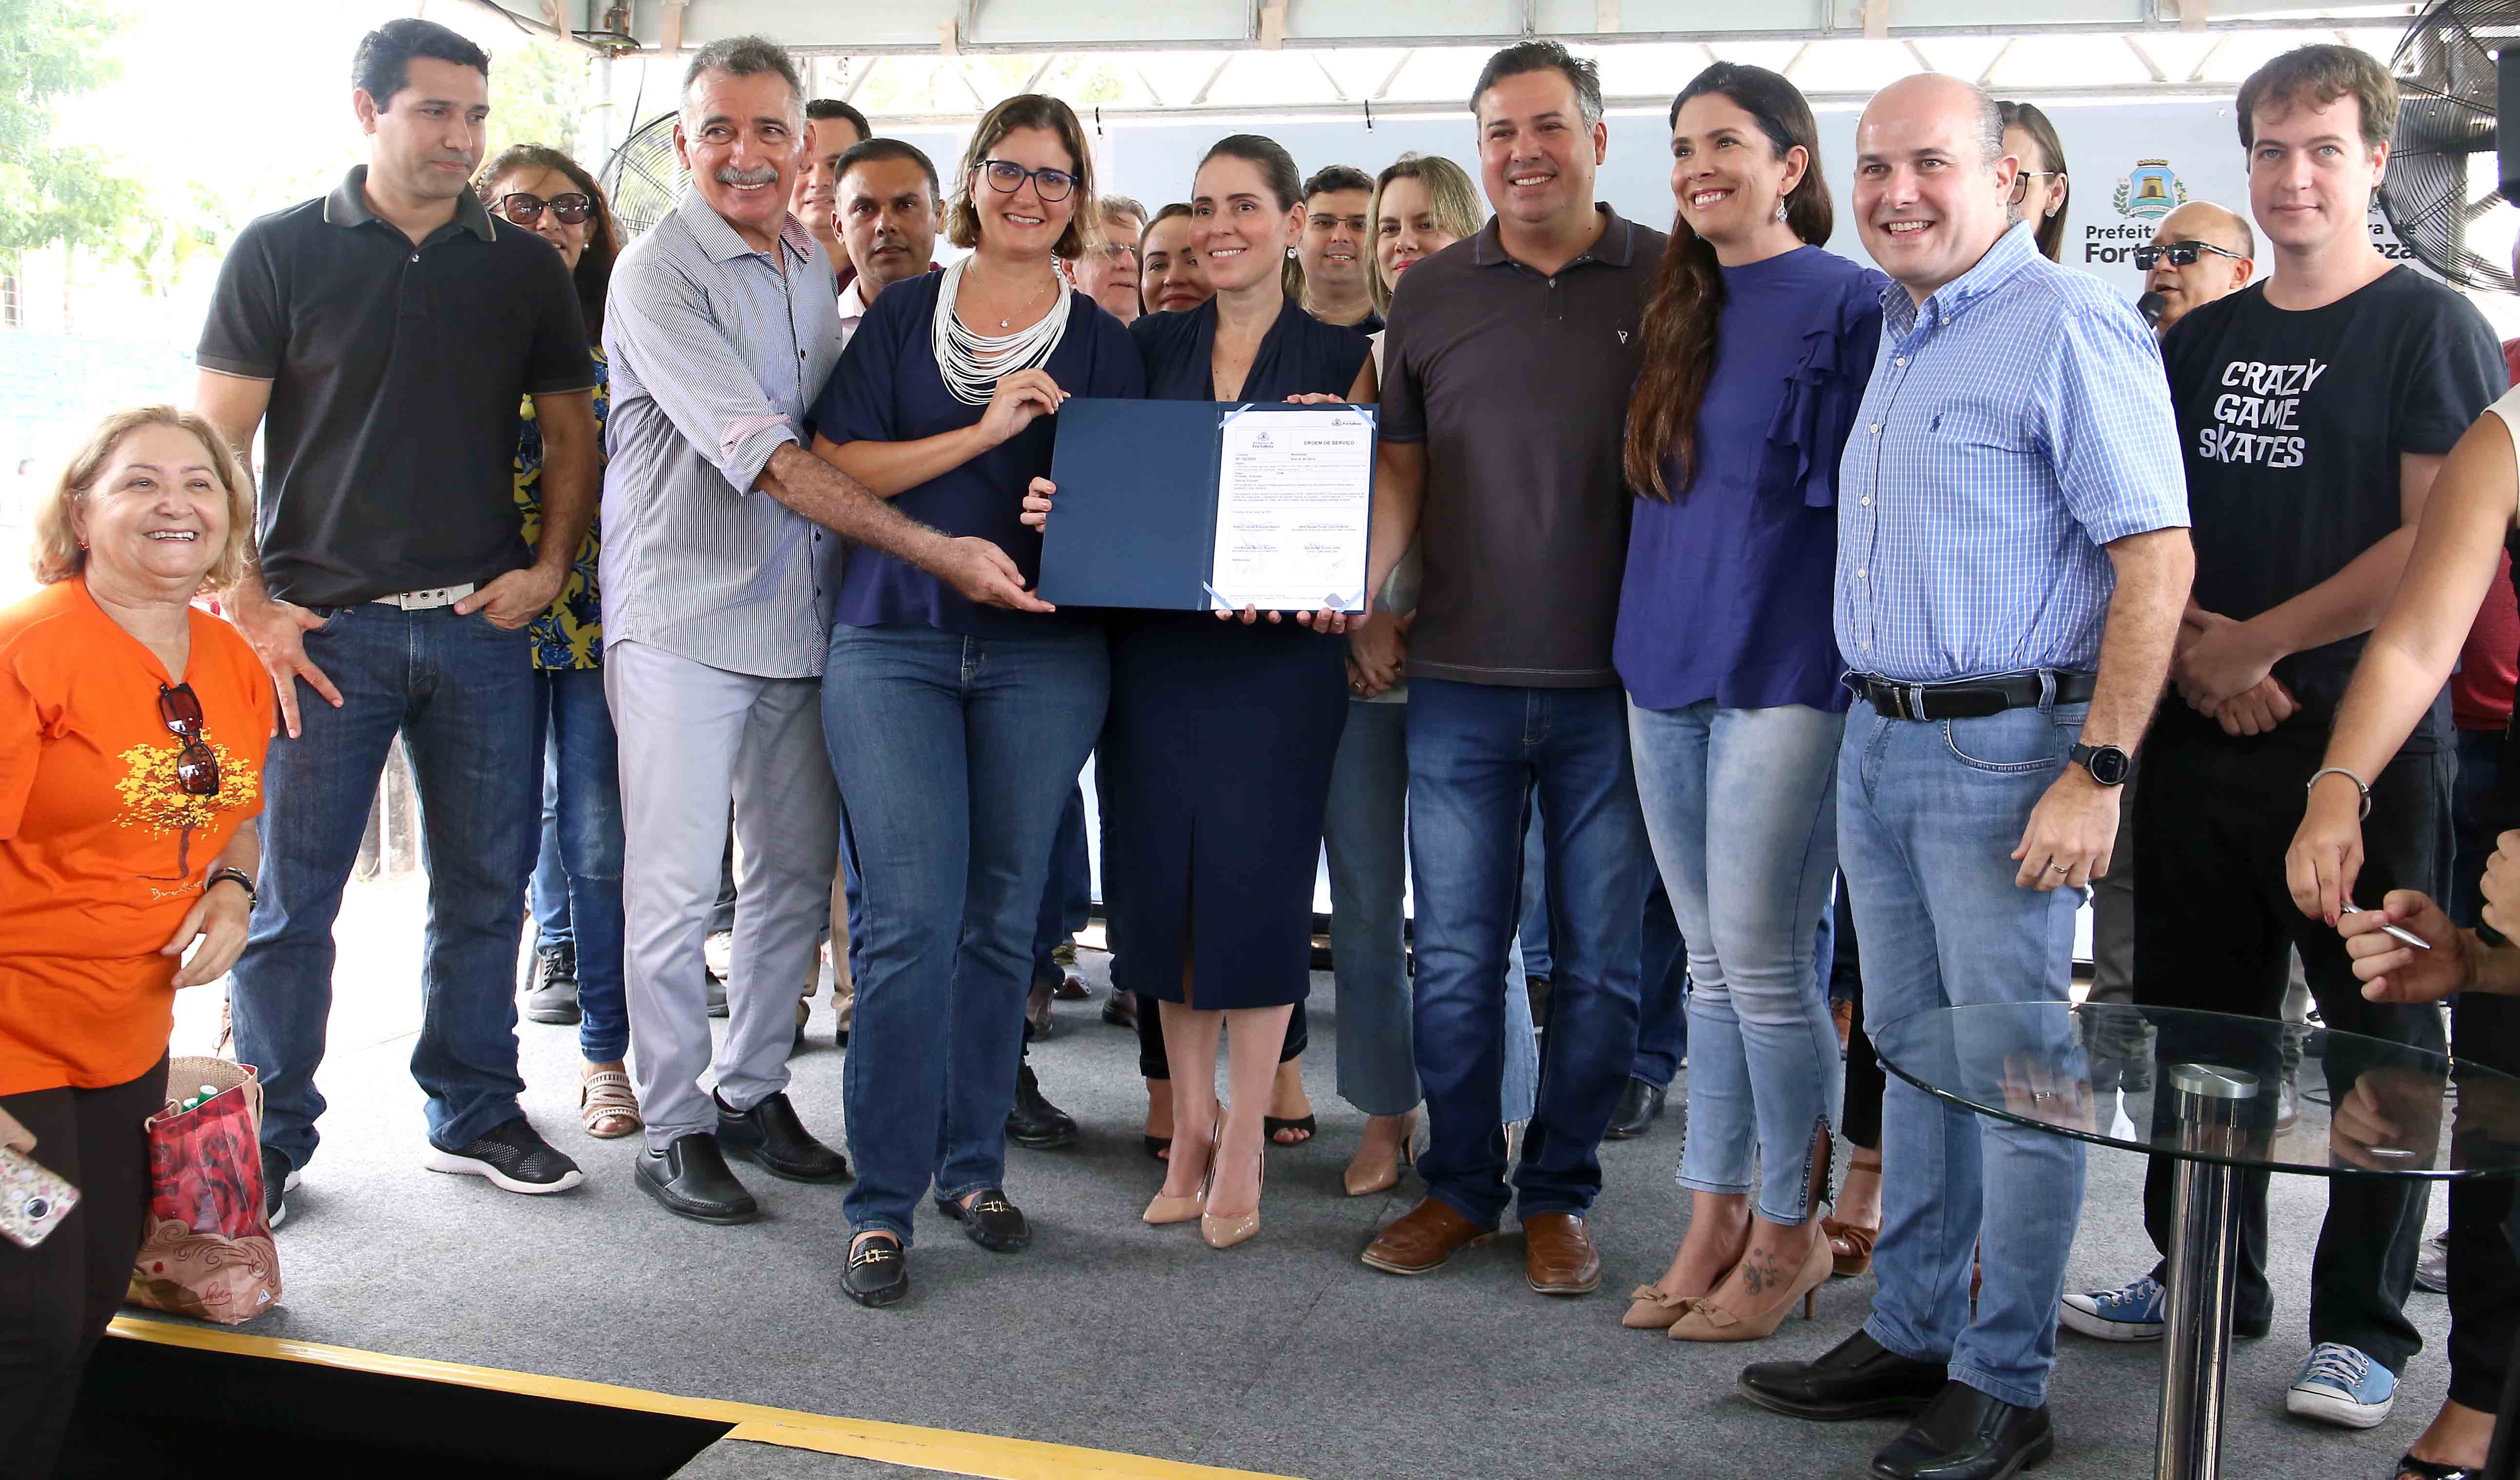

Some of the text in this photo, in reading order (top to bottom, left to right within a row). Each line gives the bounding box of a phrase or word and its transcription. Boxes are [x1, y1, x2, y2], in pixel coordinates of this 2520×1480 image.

[2086, 224, 2155, 238] Prefeit
[2222, 358, 2327, 395] CRAZY
[2214, 394, 2300, 430] GAME
[2199, 423, 2305, 468] SKATES
